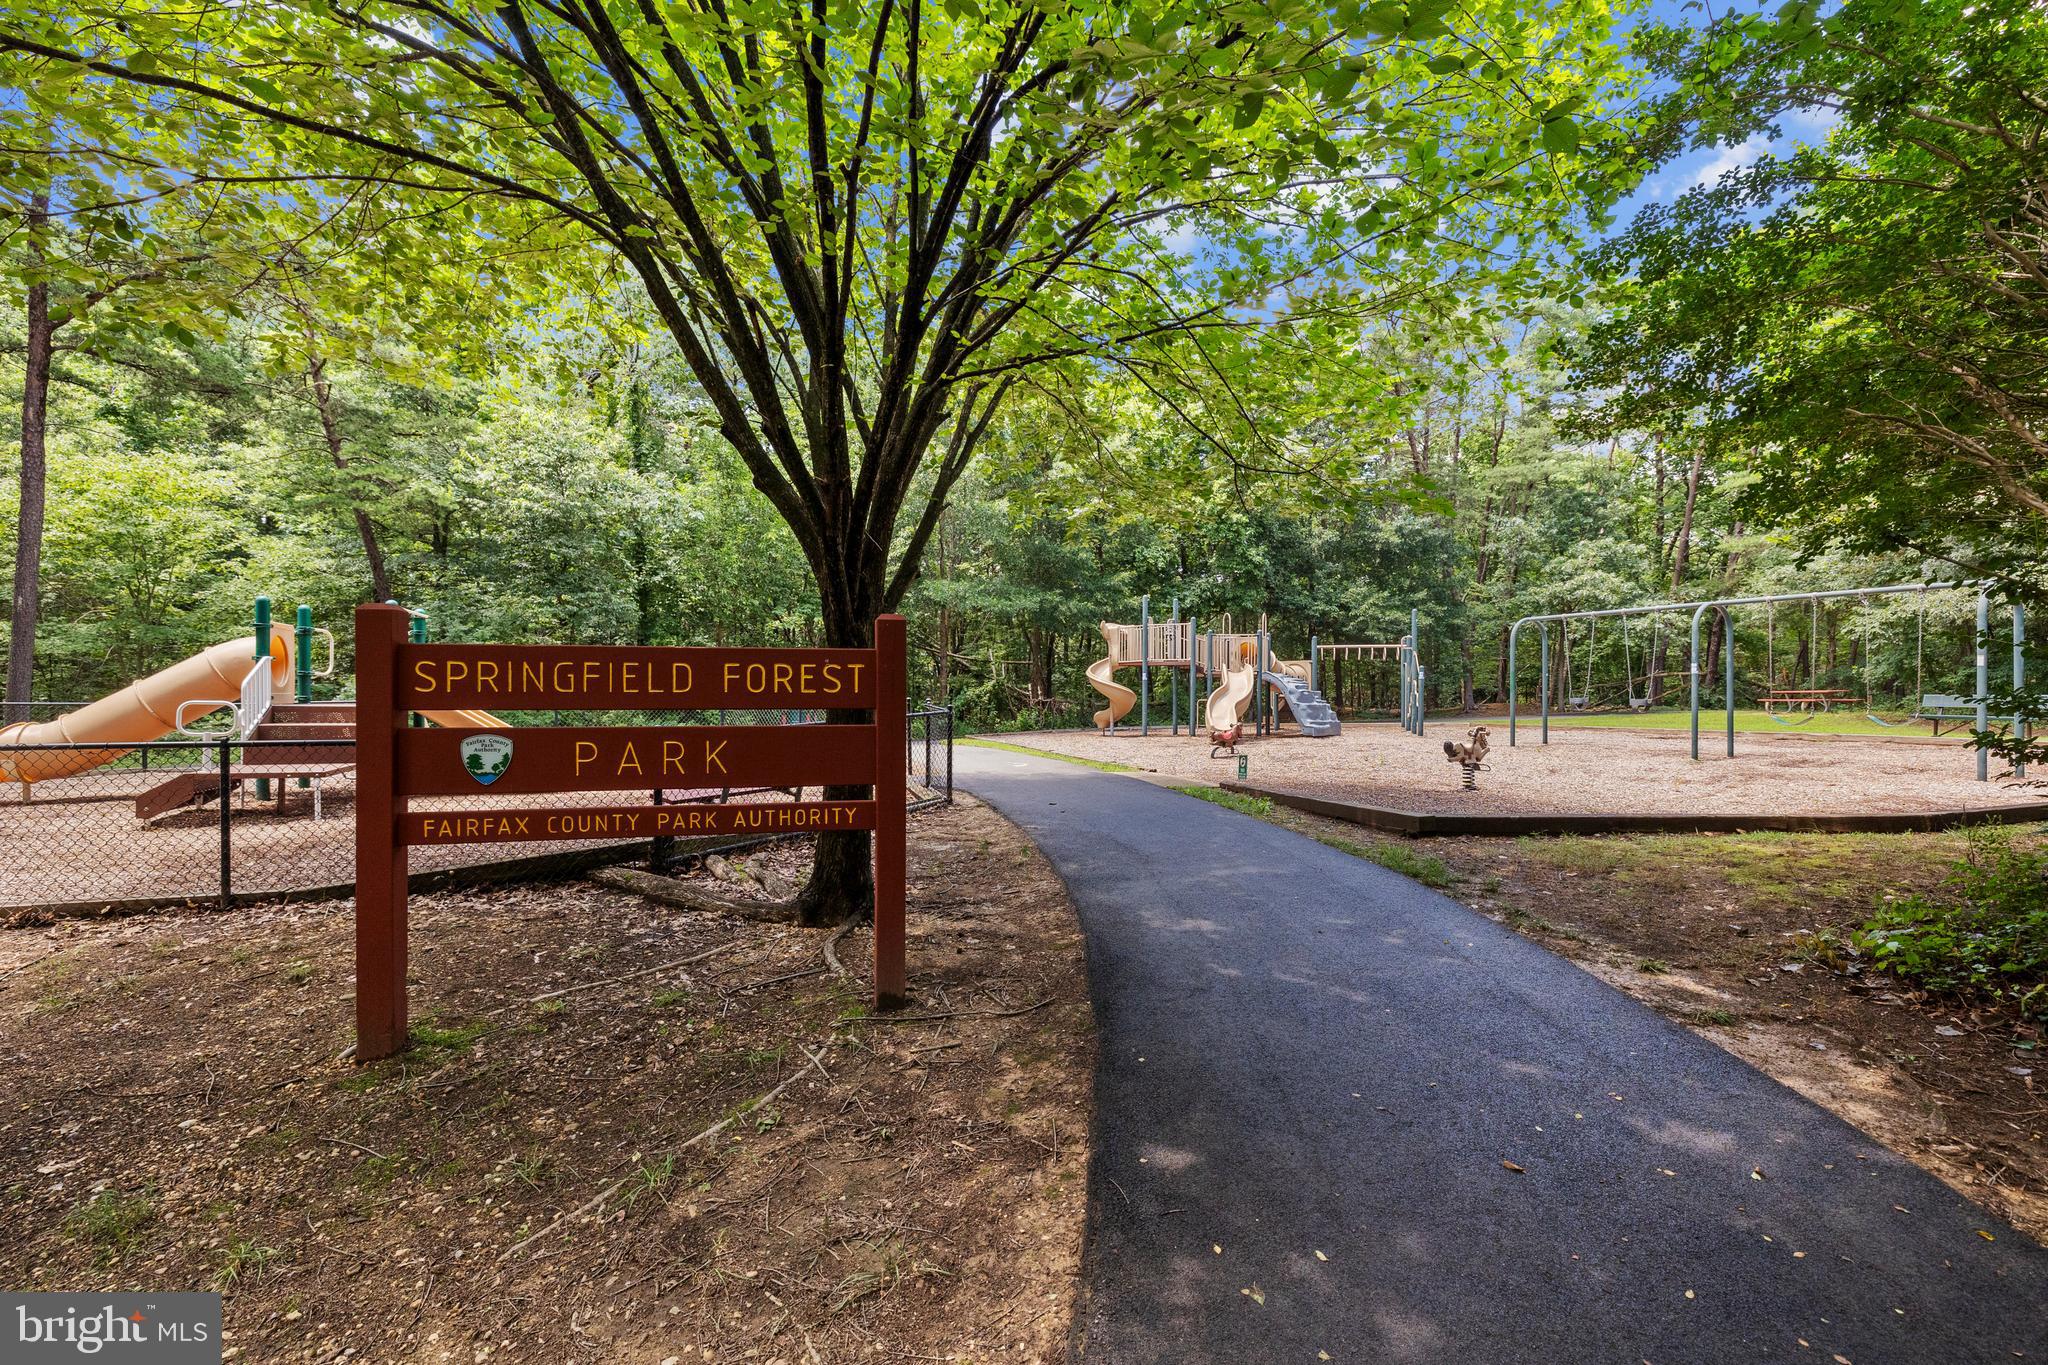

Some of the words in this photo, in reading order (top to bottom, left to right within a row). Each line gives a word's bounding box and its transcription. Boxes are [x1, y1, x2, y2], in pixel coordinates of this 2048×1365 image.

[414, 661, 693, 693] SPRINGFIELD
[723, 663, 865, 694] FOREST
[465, 738, 486, 747] Fairfax
[489, 738, 510, 748] County
[575, 740, 728, 777] PARK
[423, 817, 530, 838] FAIRFAX
[547, 813, 640, 834] COUNTY
[657, 811, 718, 830] PARK
[734, 807, 857, 829] AUTHORITY
